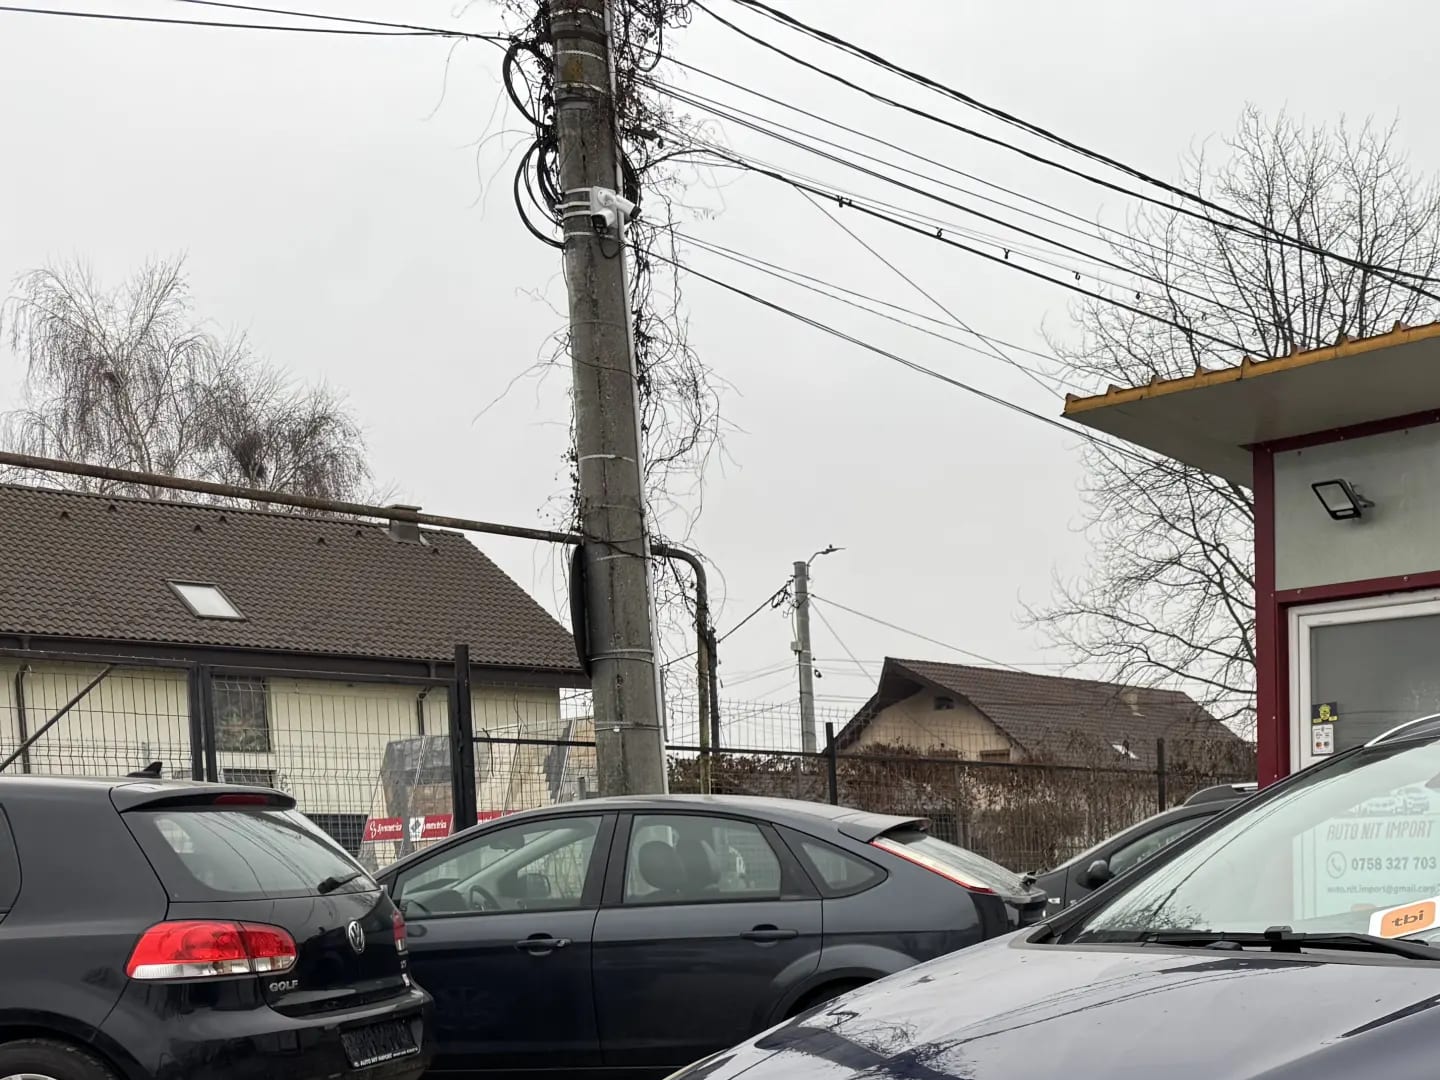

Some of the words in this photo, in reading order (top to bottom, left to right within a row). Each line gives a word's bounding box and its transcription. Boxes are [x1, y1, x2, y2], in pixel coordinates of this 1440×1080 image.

[1327, 822, 1358, 841] AUTO
[1361, 821, 1384, 840] NIT
[1385, 820, 1435, 840] IMPORT
[1351, 858, 1382, 871] 0758
[1386, 857, 1409, 870] 327
[1413, 856, 1437, 870] 703
[1391, 910, 1425, 928] tbi
[269, 979, 299, 992] GOLF
